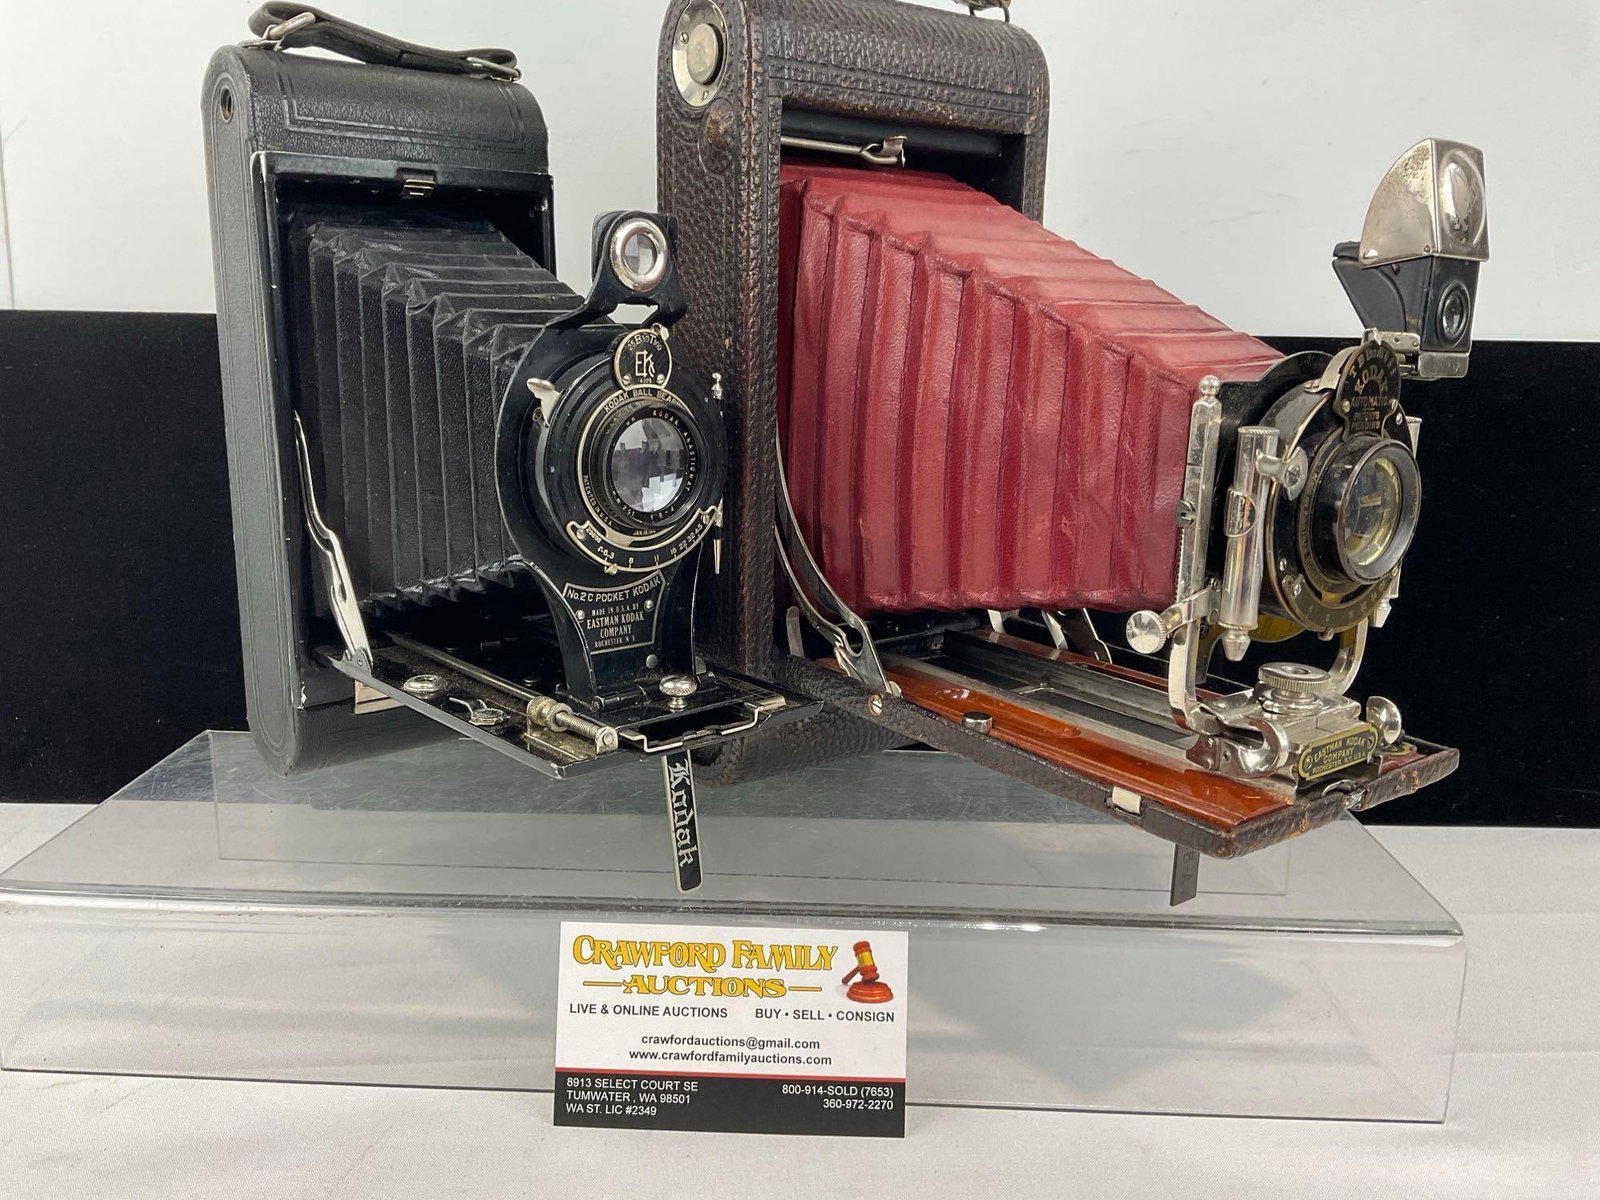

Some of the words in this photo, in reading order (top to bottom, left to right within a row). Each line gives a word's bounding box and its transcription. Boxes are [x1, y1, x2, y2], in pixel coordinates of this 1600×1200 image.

[604, 389, 629, 413] KODAK
[632, 388, 653, 398] BALL
[1351, 395, 1389, 408] AUTOMATIC
[652, 410, 680, 426] KODAK
[678, 539, 688, 550] 22
[595, 590, 631, 603] POCKET
[632, 575, 662, 597] KODAK
[586, 614, 620, 630] EASTMAN
[621, 610, 645, 625] KODAK
[600, 623, 632, 639] COMPANY
[1313, 739, 1343, 763] EASTMAN
[1346, 736, 1367, 747] KODAK
[1323, 746, 1355, 764] COMPANY
[572, 934, 727, 974] CRAWFORD
[731, 939, 839, 973] FAMILY
[622, 974, 788, 999] AUCTIONS
[569, 1003, 598, 1015] LIVE
[600, 1003, 610, 1015] &
[612, 1004, 660, 1017] ONLINE
[662, 1006, 728, 1019] AUCTIONS
[754, 1008, 782, 1020] BUY
[792, 1009, 825, 1021] SELL
[836, 1010, 895, 1023] CONSIGN
[641, 1034, 820, 1050] crawfordauctions@gmail.com
[629, 1050, 832, 1066] www.crawfordfamilyauctions.com
[566, 1077, 592, 1088] 8913
[594, 1078, 638, 1090] SELECT
[640, 1079, 681, 1092] COURT
[683, 1081, 699, 1092] SE
[782, 1084, 858, 1097] 800-914-SOLD
[860, 1086, 894, 1099] (7653)
[566, 1090, 631, 1102] TUMWATER
[639, 1092, 658, 1103] WA
[659, 1093, 691, 1104] 98501
[823, 1098, 894, 1111] 360-972-2270
[565, 1103, 584, 1114] WA
[586, 1103, 602, 1114] ST.
[605, 1104, 623, 1115] LIC
[625, 1105, 657, 1117] #2349
